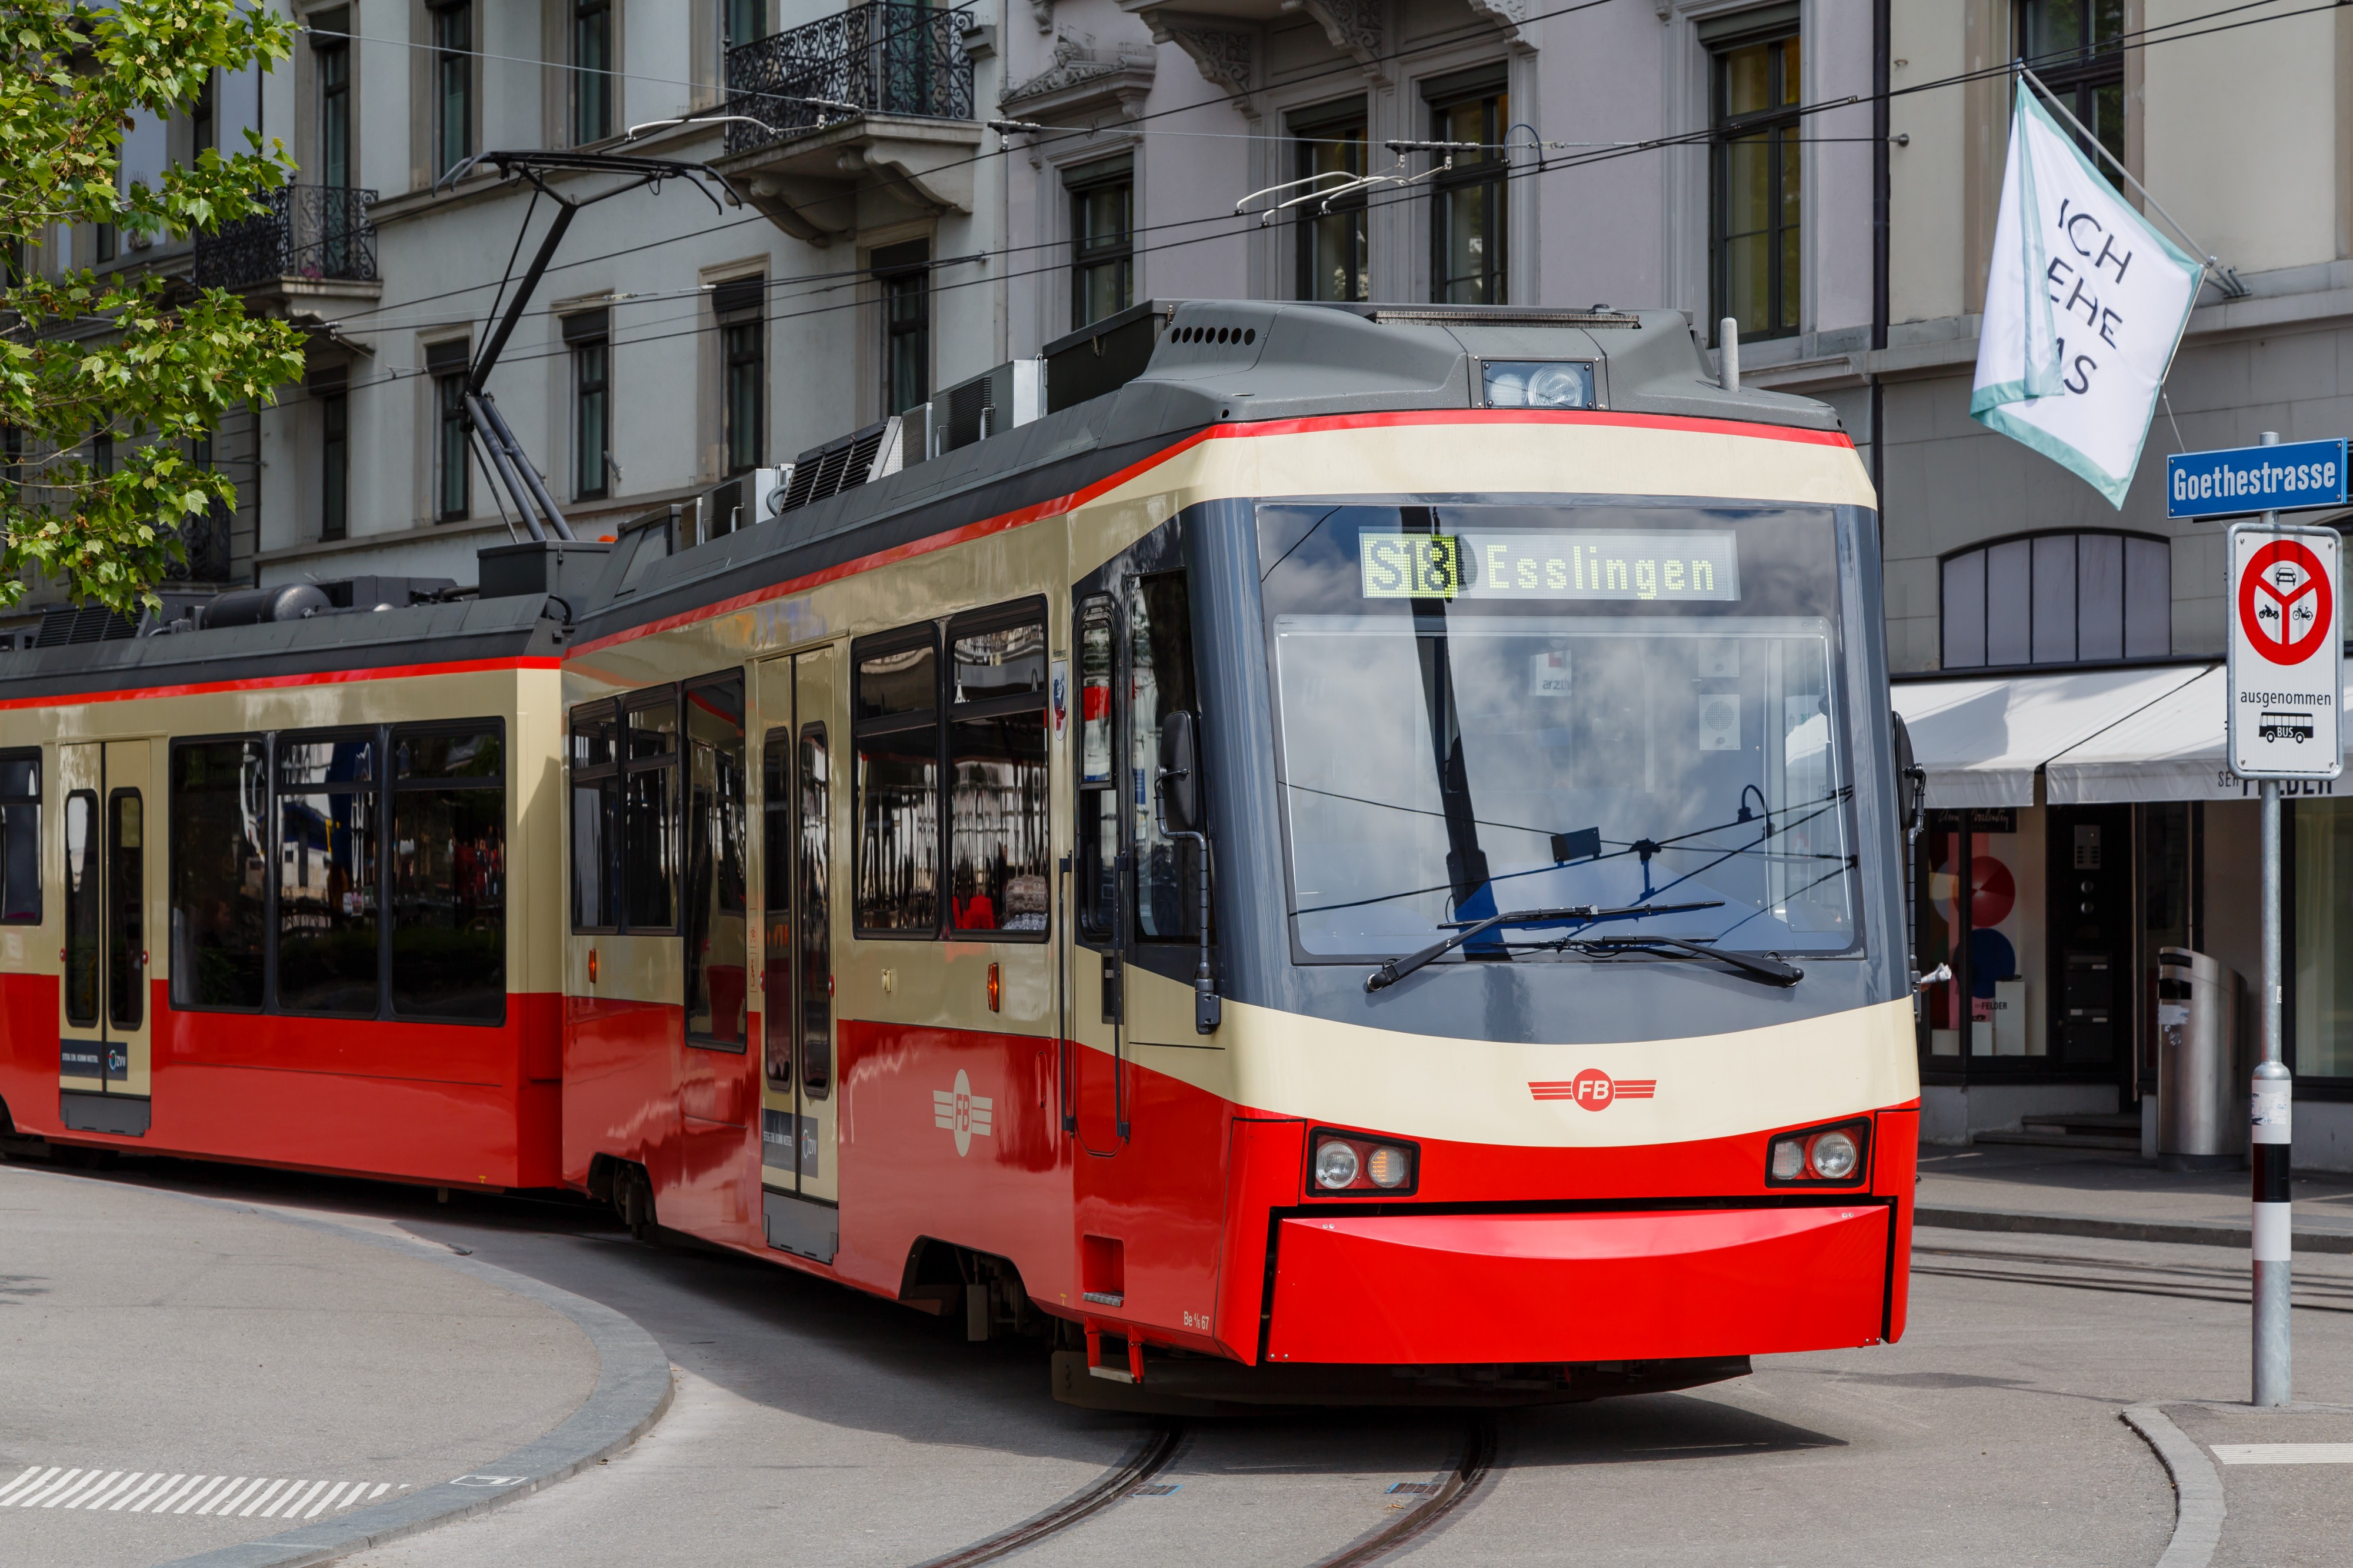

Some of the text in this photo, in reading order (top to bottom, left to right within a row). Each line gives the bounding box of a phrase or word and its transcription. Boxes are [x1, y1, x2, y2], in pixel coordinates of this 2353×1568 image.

[2058, 198, 2132, 285] ICH
[2174, 461, 2336, 501] Goethestrasse
[1370, 539, 1714, 600] S18 Esslingen
[2240, 691, 2332, 708] ausgenommen
[2277, 726, 2294, 738] BUS
[1981, 1001, 2008, 1010] FELDER
[116, 1055, 126, 1067] ZVV
[1577, 1080, 1609, 1100] FB
[955, 1093, 970, 1132] FB
[808, 1138, 817, 1156] ZVV
[1184, 1310, 1193, 1327] Be
[1201, 1315, 1209, 1330] 67
